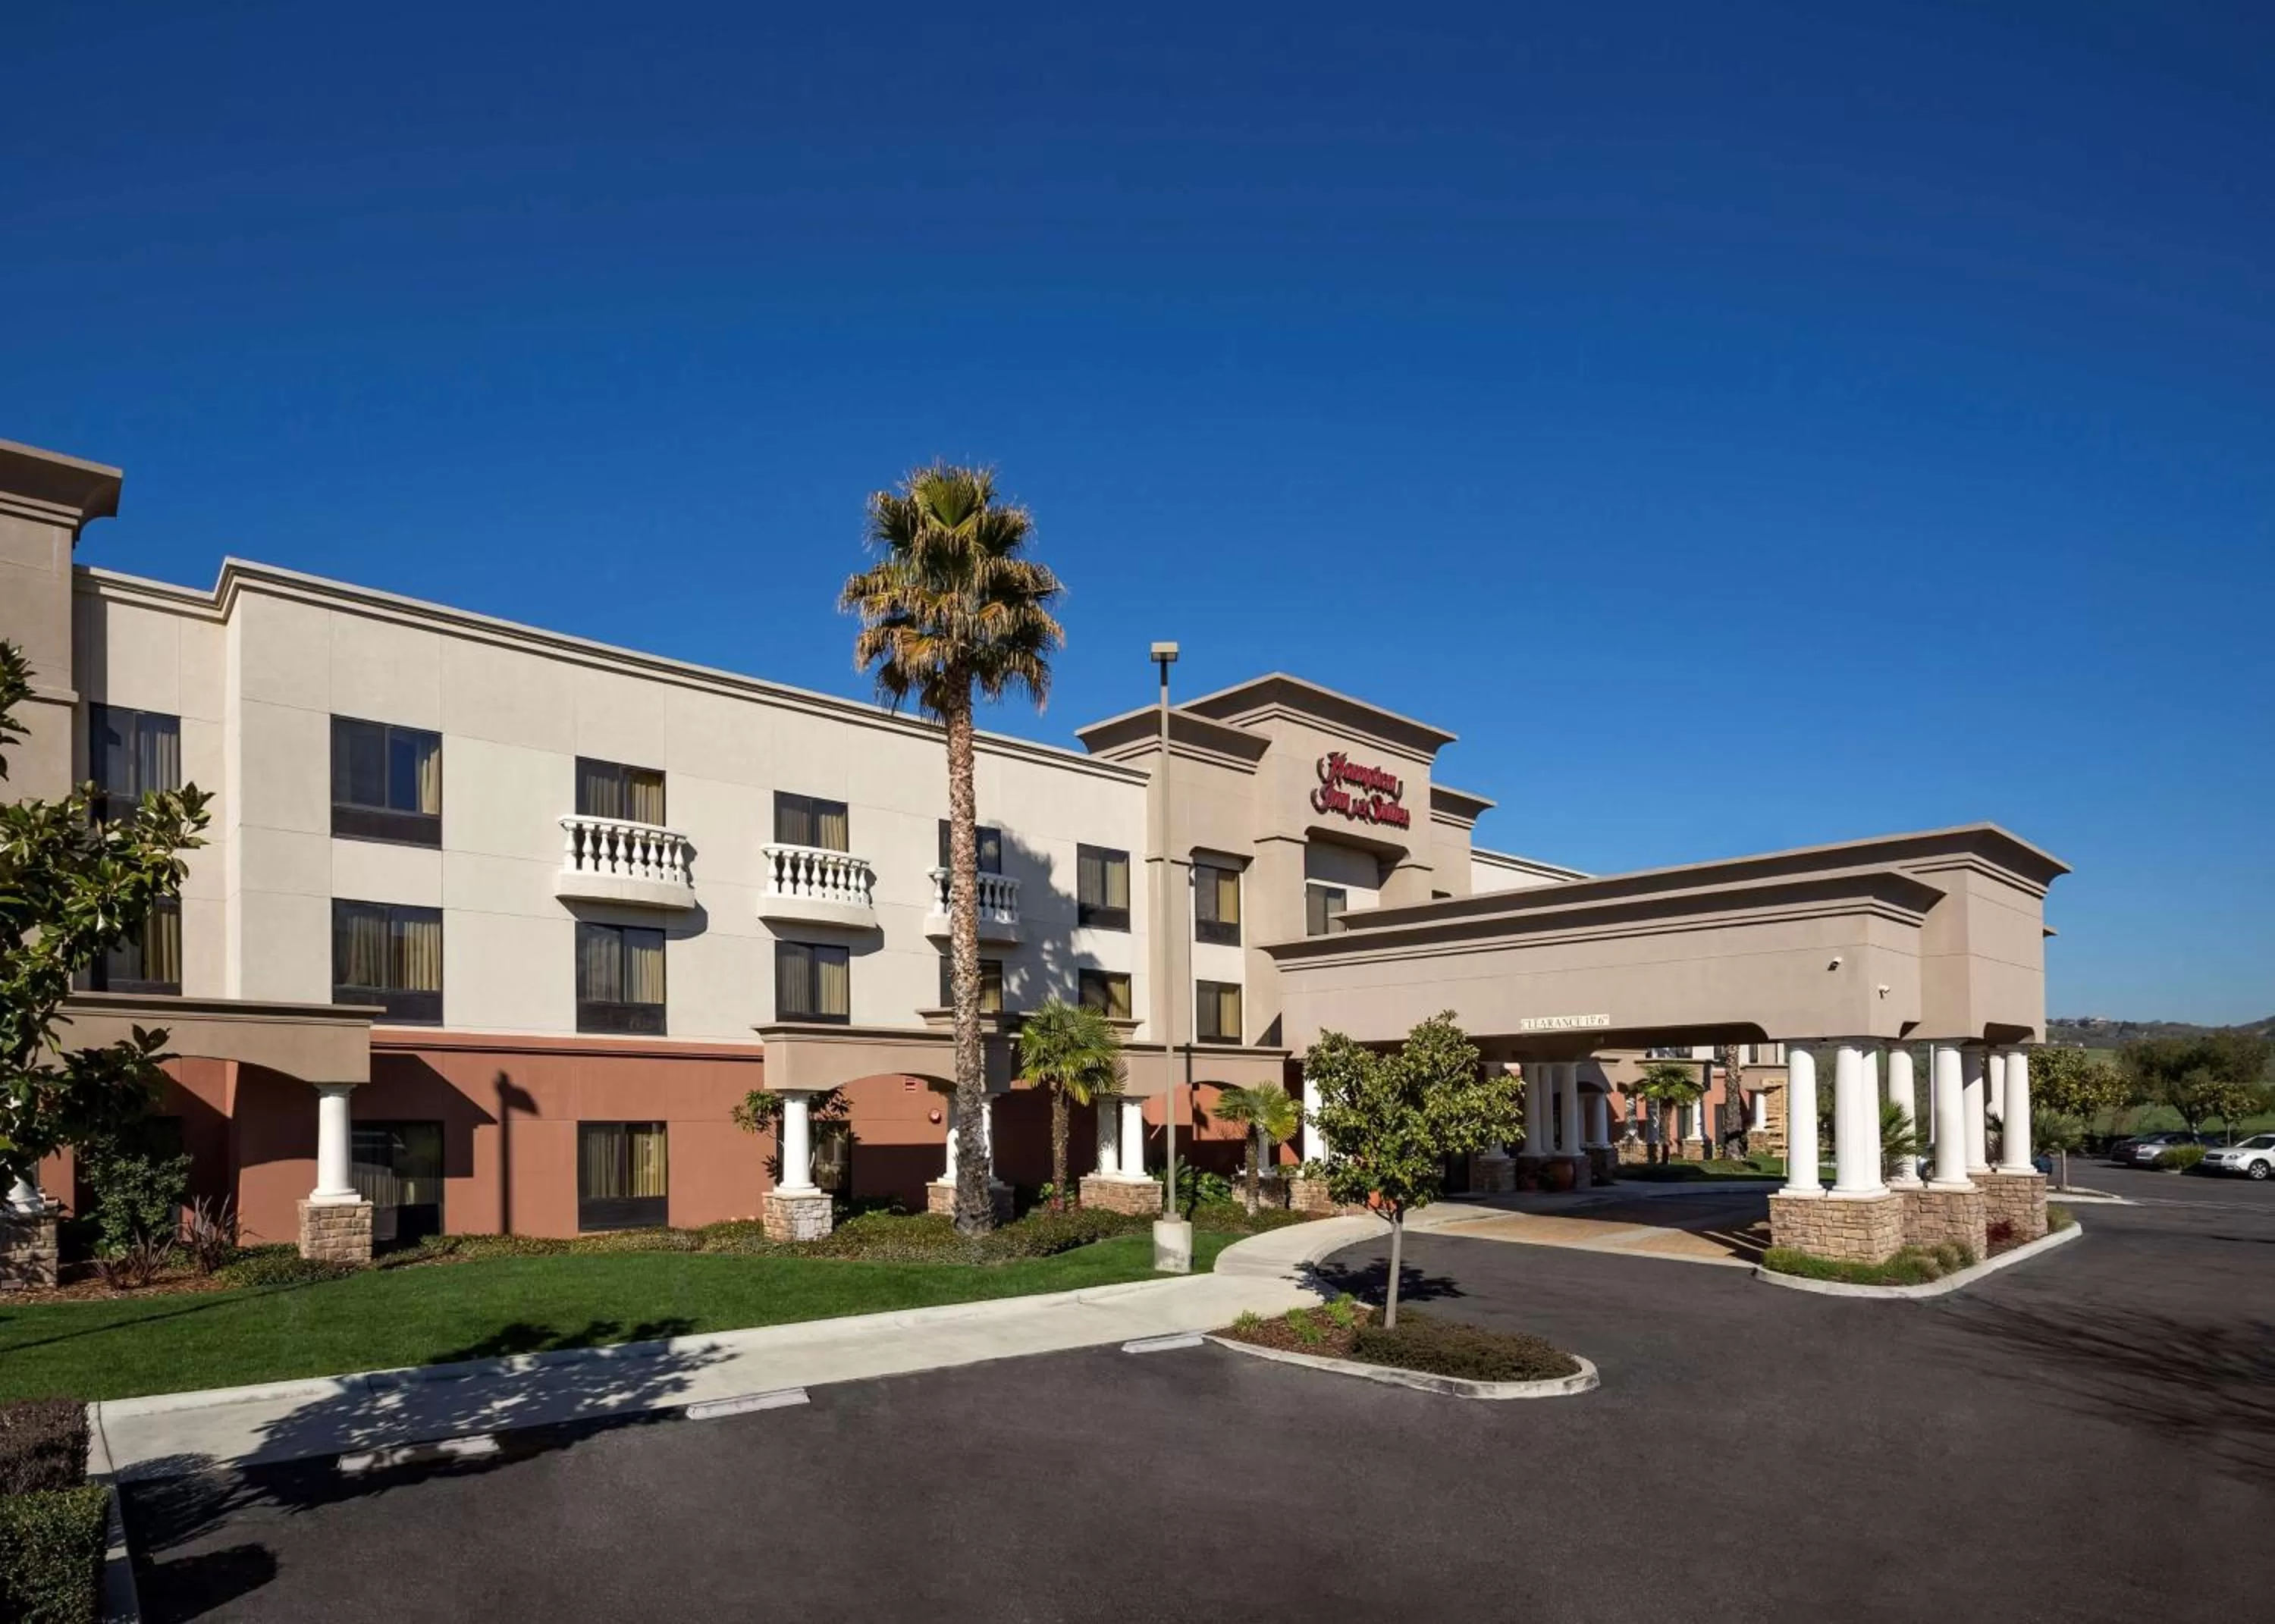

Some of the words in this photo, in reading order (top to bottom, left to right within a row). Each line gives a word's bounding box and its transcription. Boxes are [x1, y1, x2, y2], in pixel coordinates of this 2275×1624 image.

[1316, 751, 1403, 801] Hampton
[1310, 784, 1356, 820] Inn
[1368, 795, 1410, 830] Suites
[1521, 1017, 1583, 1030] CLEARANCE
